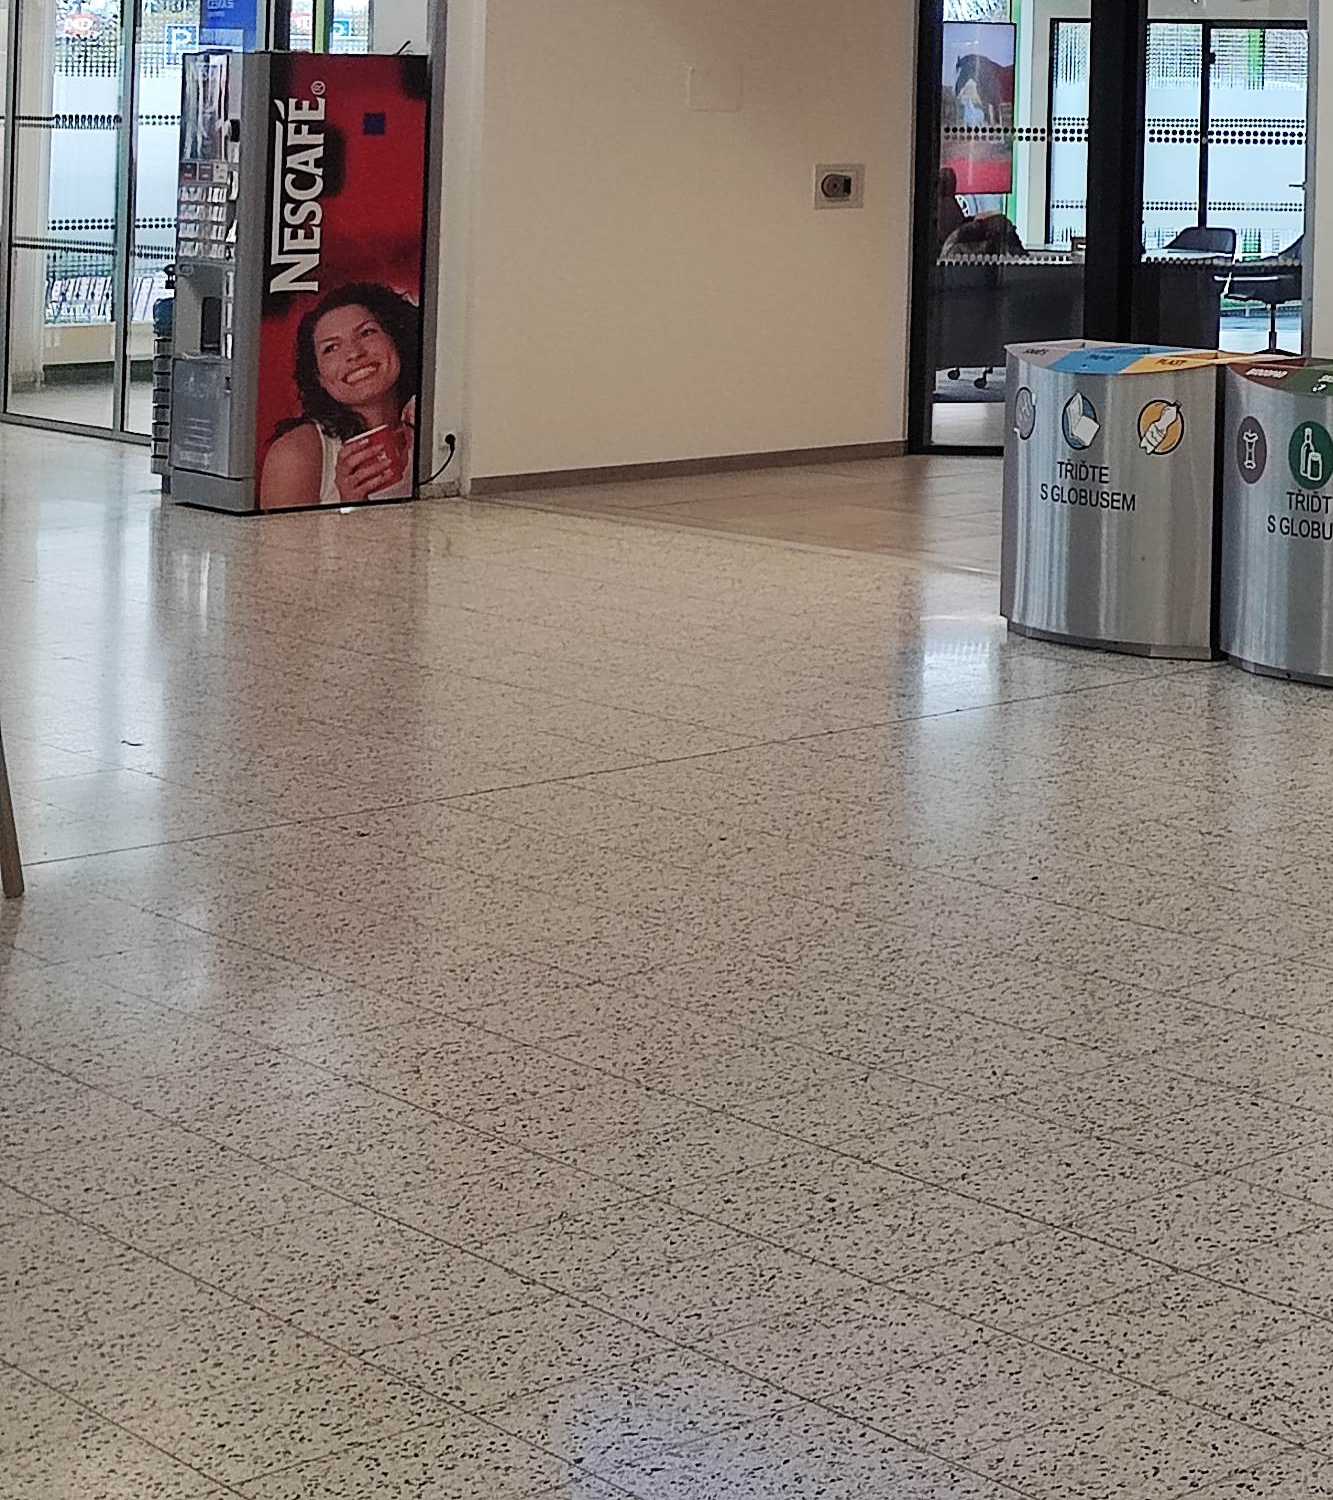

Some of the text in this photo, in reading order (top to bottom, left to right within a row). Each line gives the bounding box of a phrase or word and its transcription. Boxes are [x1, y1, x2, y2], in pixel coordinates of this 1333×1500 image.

[1057, 459, 1109, 484] TŘIĎTE
[1040, 483, 1136, 511] S GLOBUSEM
[1267, 514, 1276, 533] S
